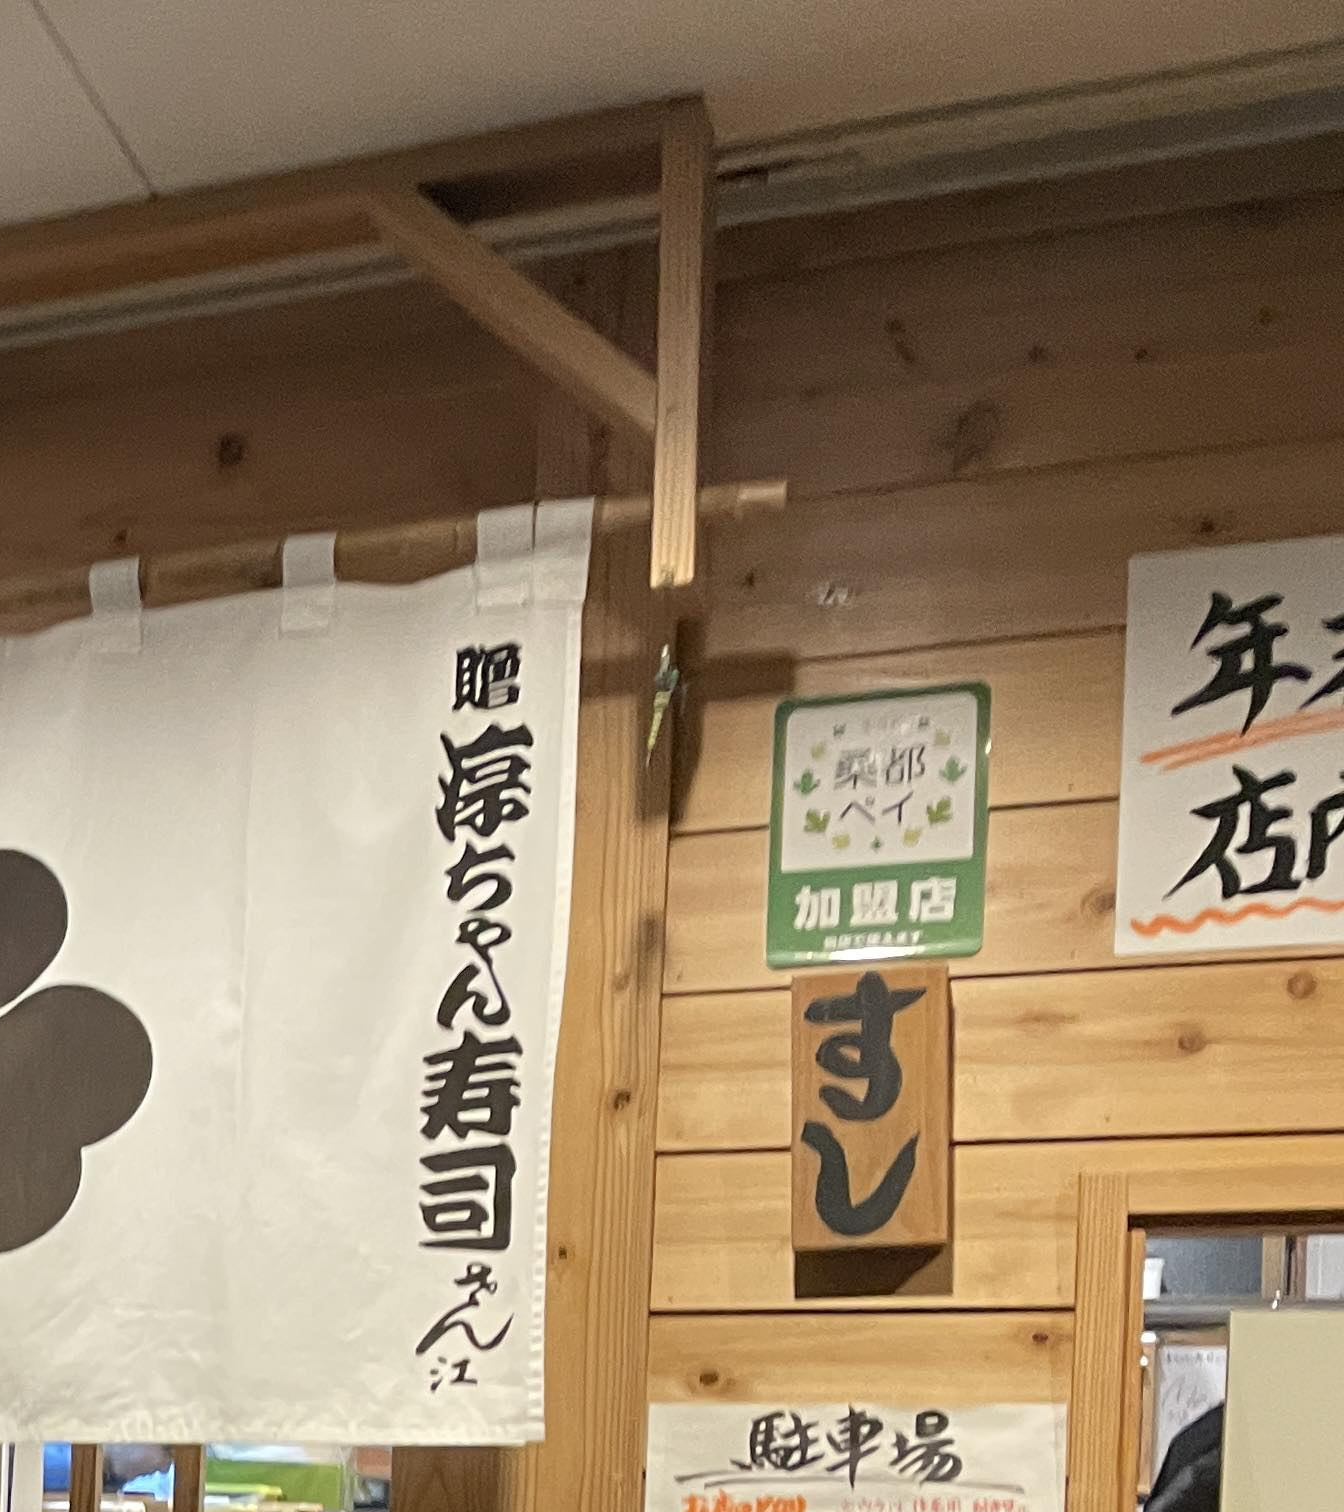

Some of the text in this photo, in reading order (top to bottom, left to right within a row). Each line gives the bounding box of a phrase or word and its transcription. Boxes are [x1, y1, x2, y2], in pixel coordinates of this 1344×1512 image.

[793, 876, 957, 932] 加盟店
[800, 970, 927, 1236] すし
[729, 1402, 964, 1490] 駐車場
